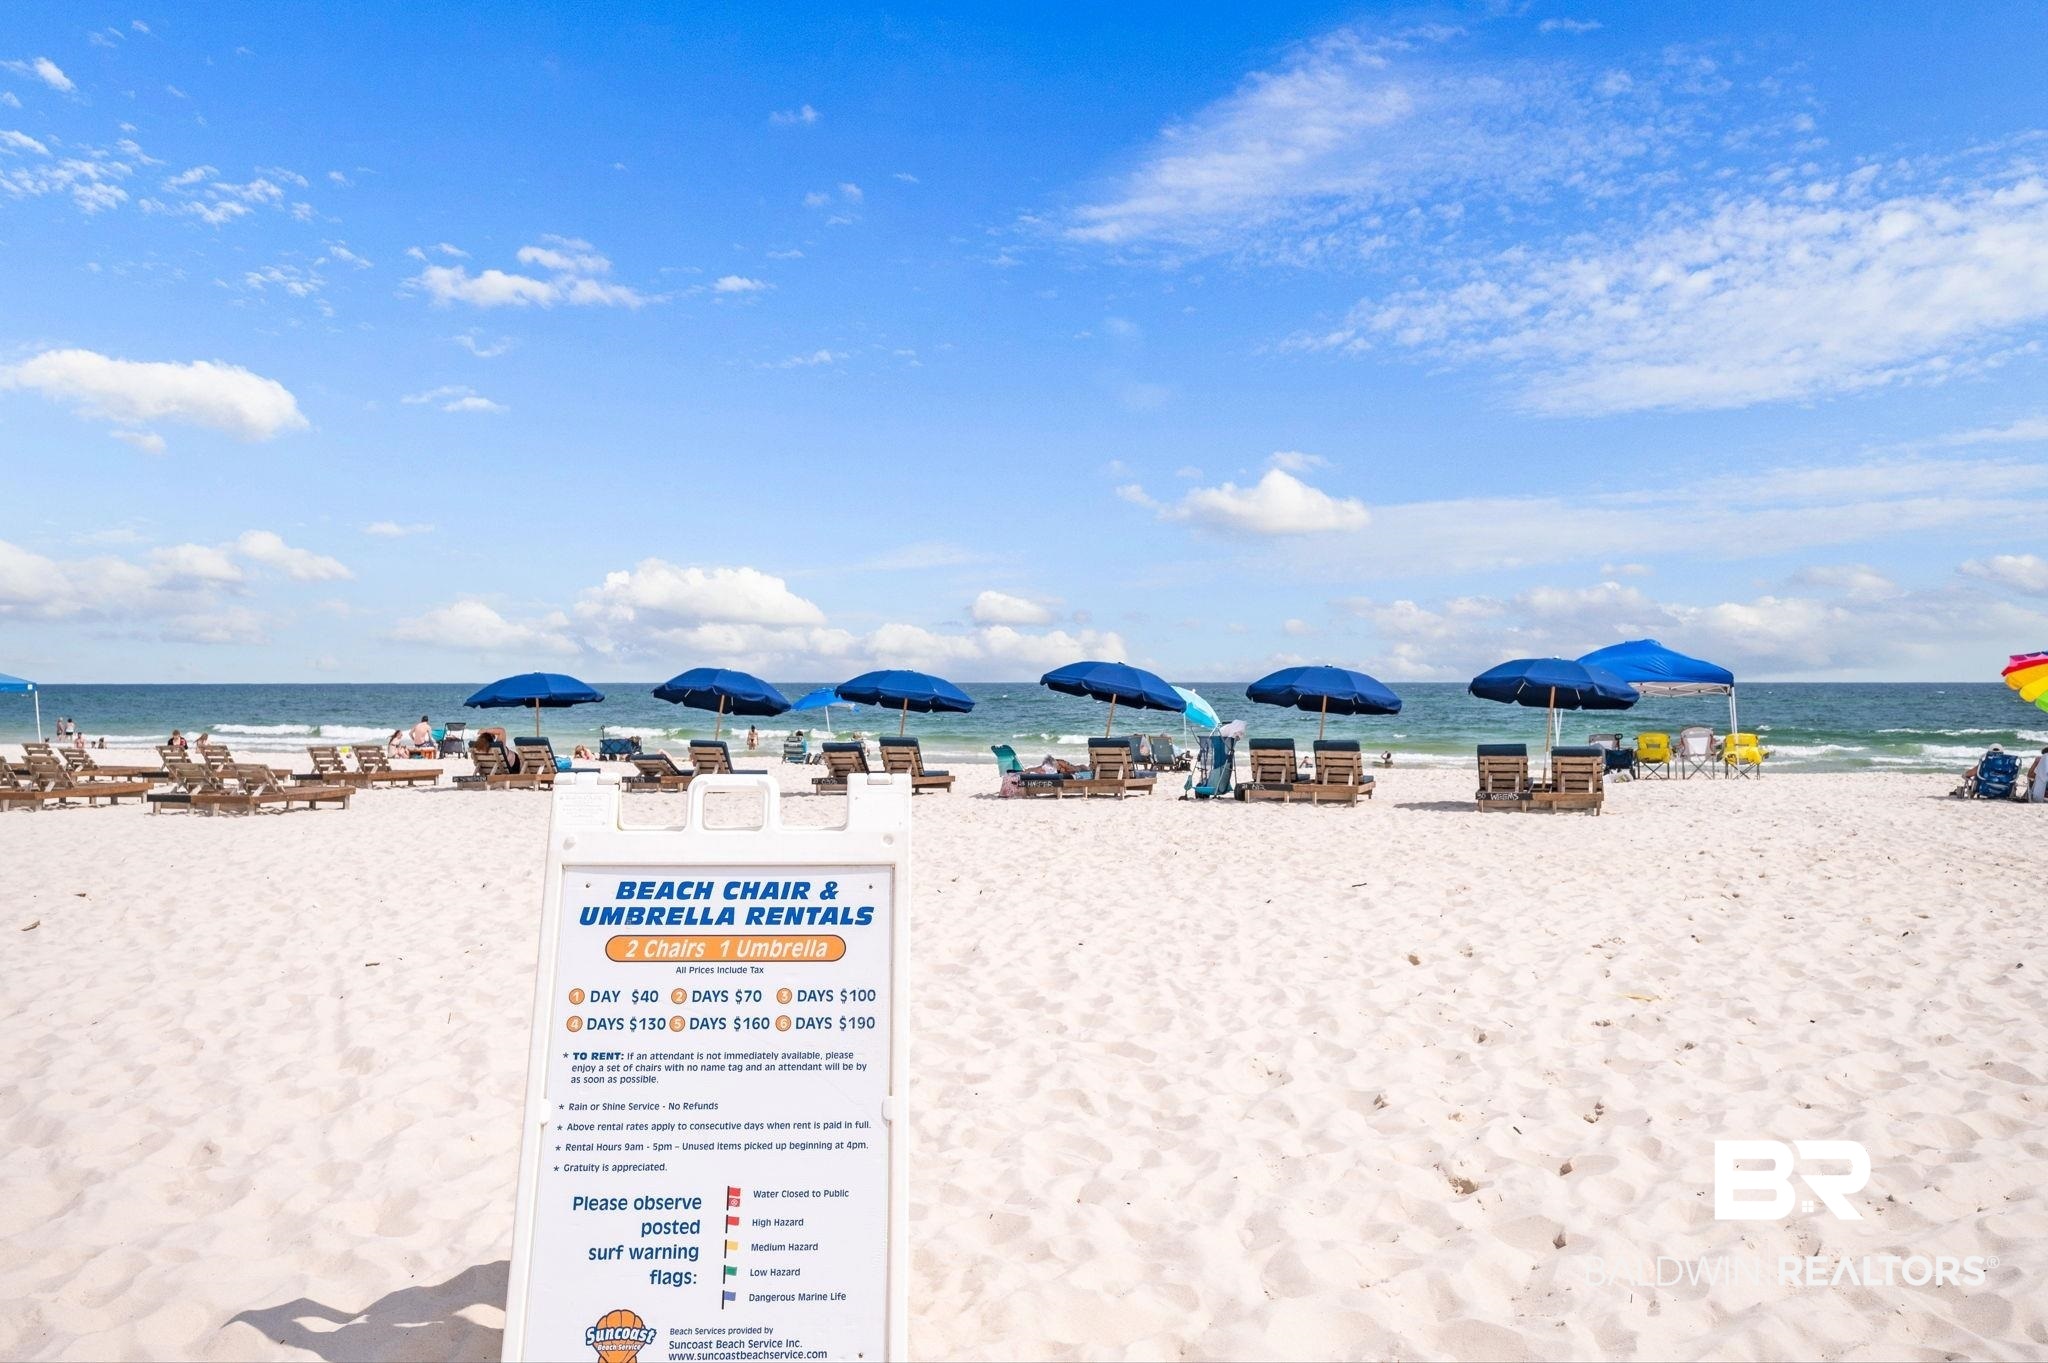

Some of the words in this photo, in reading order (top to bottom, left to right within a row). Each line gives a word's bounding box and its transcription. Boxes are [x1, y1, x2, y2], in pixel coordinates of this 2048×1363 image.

[616, 881, 714, 900] BEACH
[723, 881, 810, 900] CHAIR
[820, 881, 839, 900] &
[580, 907, 735, 925] UMBRELLA
[745, 906, 874, 925] RENTALS
[625, 939, 639, 958] 2
[644, 939, 706, 958] Chairs
[720, 939, 731, 957] 1
[736, 939, 828, 958] Umbrella
[675, 966, 687, 975] All
[688, 965, 715, 975] Prices
[716, 965, 748, 975] Include
[749, 965, 765, 974] Tax
[590, 990, 620, 1002] DAY
[632, 990, 658, 1004] $40
[692, 990, 728, 1002] DAYS
[736, 989, 762, 1004] $70
[798, 990, 833, 1002] DAYS
[840, 988, 876, 1004] $100
[587, 1018, 624, 1030] DAYS
[630, 1017, 666, 1032] $130
[690, 1018, 726, 1030] DAYS
[734, 1016, 770, 1031] $160
[796, 1017, 832, 1029] DAYS
[840, 1016, 875, 1031] $190
[572, 1051, 588, 1061] TO
[590, 1051, 625, 1061] RENT:
[627, 1051, 635, 1061] If
[635, 1053, 648, 1061] an
[649, 1051, 695, 1061] attendant
[696, 1051, 704, 1061] is
[705, 1051, 722, 1061] not
[723, 1051, 779, 1061] immediately
[781, 1051, 823, 1061] available,
[825, 1051, 854, 1061] please
[571, 1063, 597, 1074] enjoy
[598, 1064, 605, 1073] a
[606, 1063, 621, 1073] set
[622, 1063, 634, 1073] of
[635, 1063, 663, 1073] chairs
[664, 1063, 685, 1072] with
[686, 1064, 699, 1072] no
[700, 1064, 726, 1072] name
[727, 1063, 744, 1073] tag
[745, 1063, 763, 1072] and
[764, 1063, 776, 1072] an
[777, 1062, 823, 1072] attendant
[824, 1062, 841, 1071] will
[842, 1062, 854, 1071] be
[855, 1061, 868, 1072] by
[570, 1076, 581, 1084] as
[583, 1076, 605, 1084] soon
[607, 1075, 618, 1084] as
[619, 1075, 659, 1085] possible.
[568, 1102, 588, 1111] Rain
[589, 1103, 601, 1111] or
[601, 1102, 626, 1111] Shine
[627, 1102, 661, 1111] Service
[667, 1101, 681, 1111] No
[682, 1101, 719, 1111] Refunds
[566, 1122, 595, 1132] Above
[597, 1122, 624, 1132] rental
[625, 1123, 649, 1131] rates
[650, 1122, 676, 1132] apply
[677, 1122, 688, 1131] to
[689, 1121, 743, 1131] consecutive
[743, 1121, 765, 1131] days
[766, 1121, 791, 1130] when
[792, 1121, 812, 1130] rent
[813, 1121, 821, 1130] is
[823, 1120, 843, 1131] paid
[844, 1120, 853, 1129] in
[854, 1120, 872, 1129] full.
[565, 1143, 595, 1152] Rental
[595, 1143, 623, 1152] Hours
[624, 1142, 644, 1151] 9am
[652, 1142, 673, 1153] 5pm
[681, 1141, 715, 1151] Unused
[716, 1141, 742, 1151] items
[743, 1141, 773, 1152] picked
[775, 1142, 787, 1151] up
[789, 1141, 833, 1151] beginning
[834, 1141, 845, 1150] at
[846, 1140, 869, 1151] 4pm.
[563, 1163, 601, 1173] Gratuity
[601, 1163, 610, 1172] is
[611, 1162, 668, 1173] appreciated.
[753, 1189, 780, 1199] Water
[781, 1189, 810, 1199] Closed
[811, 1189, 822, 1198] to
[823, 1189, 850, 1198] Public
[573, 1196, 628, 1210] Please
[634, 1196, 701, 1210] observe
[642, 1220, 700, 1237] posted
[751, 1218, 772, 1229] High
[773, 1217, 805, 1227] Hazard
[589, 1245, 624, 1260] surf
[629, 1244, 698, 1262] warning
[750, 1243, 786, 1252] Medium
[787, 1242, 819, 1252] Hazard
[650, 1270, 696, 1287] flags:
[749, 1268, 769, 1277] Low
[769, 1267, 801, 1277] Hazard
[748, 1293, 796, 1304] Dangerous
[797, 1292, 829, 1302] Marine
[829, 1291, 847, 1301] Life
[585, 1326, 657, 1346] Suncoast
[669, 1327, 693, 1336] Beach
[694, 1327, 727, 1336] Services
[727, 1326, 763, 1336] provided
[763, 1326, 774, 1335] by
[668, 1339, 714, 1350] Suncoast
[715, 1339, 745, 1349] Beach
[747, 1338, 783, 1349] Service
[785, 1338, 803, 1349] Inc.
[668, 1349, 828, 1361] www.suncoastbeachservice.com
